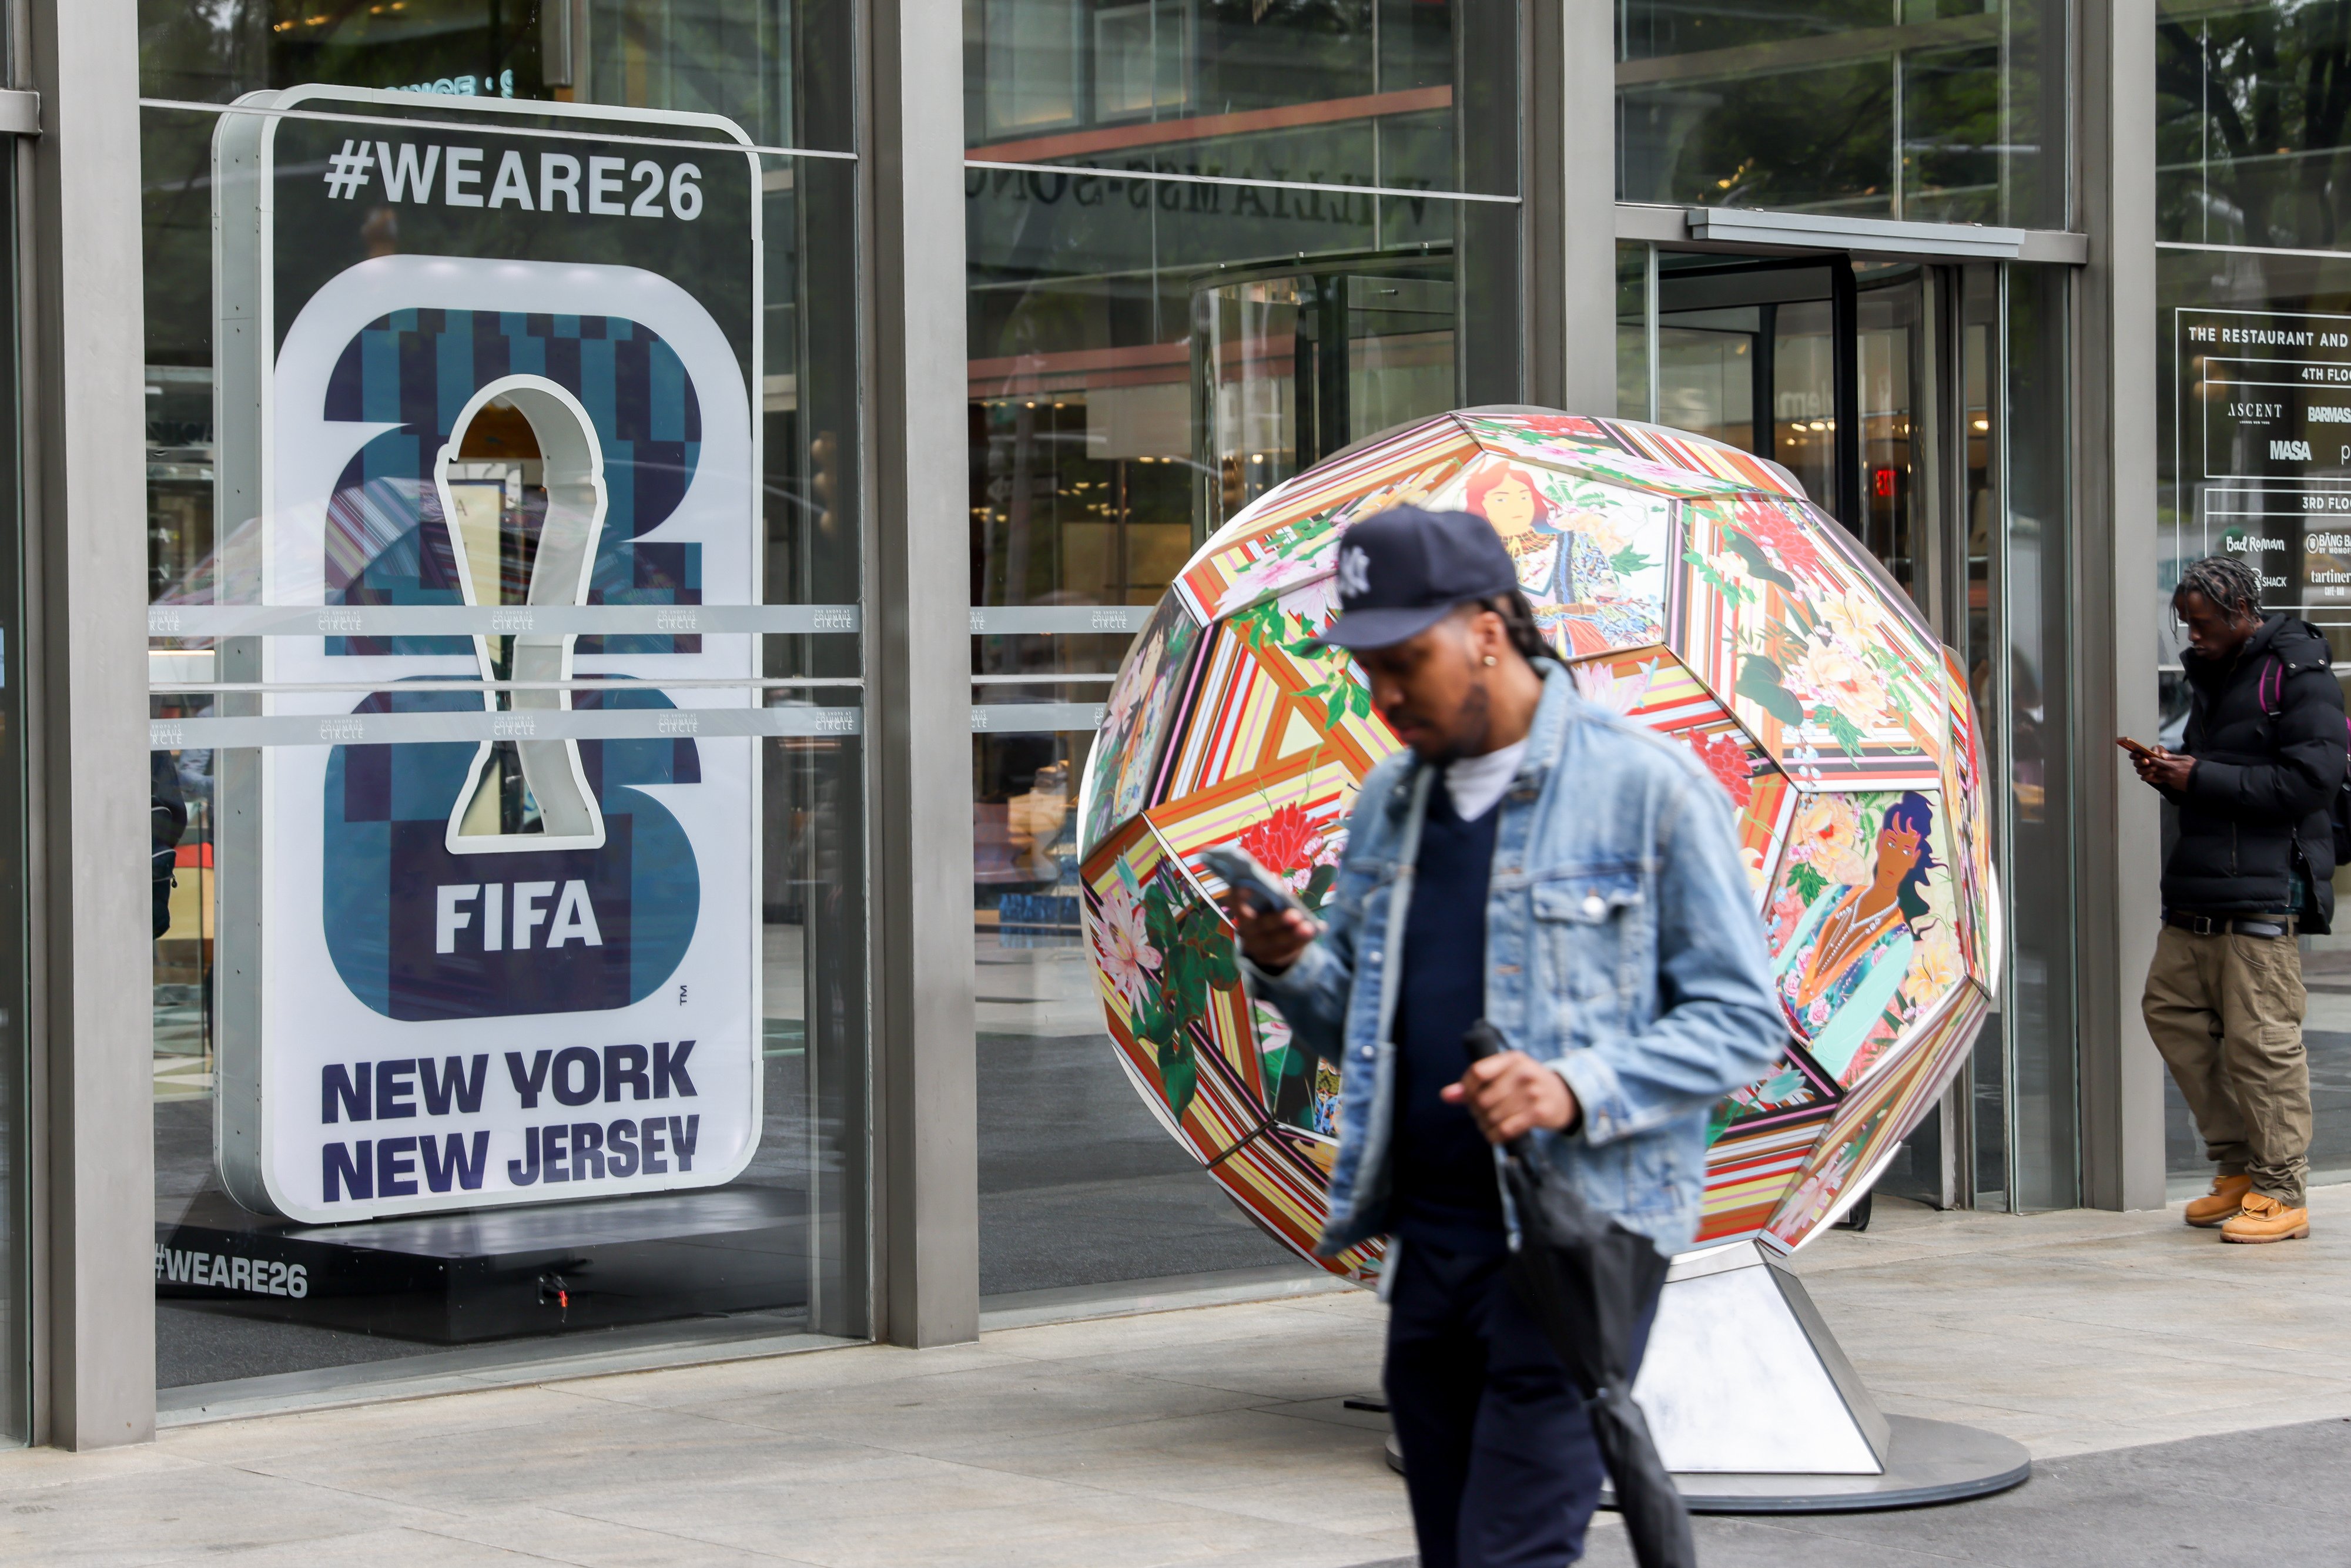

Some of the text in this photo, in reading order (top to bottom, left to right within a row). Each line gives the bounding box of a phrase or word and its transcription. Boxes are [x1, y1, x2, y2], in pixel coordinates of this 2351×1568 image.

[323, 139, 704, 222] #WEARE26
[2189, 327, 2348, 347] THE RESTAURANT AND
[2301, 367, 2323, 380] 4TH
[2228, 403, 2282, 418] ASCENT
[2270, 440, 2312, 461] MASA
[2302, 497, 2351, 510] 3RD FLO
[2226, 535, 2285, 552] Bad Roman
[2262, 577, 2287, 587] SHACK
[319, 621, 361, 630] CIRCLE
[493, 621, 533, 629] CIRCLE
[658, 620, 695, 629] CIRCLE
[814, 619, 851, 628] CIRCLE
[1093, 620, 1127, 628] CIRCLE
[494, 726, 534, 735] CIRCLE
[659, 723, 697, 732] CIRCLE
[816, 721, 852, 730] CIRCLE
[320, 729, 363, 739] CIRCLE
[436, 880, 603, 954] FIFA
[680, 985, 687, 1006] TM
[322, 1040, 698, 1124] NEW YORK
[323, 1114, 700, 1202] NEW JERSEY
[155, 1243, 307, 1298] #WEARE26
